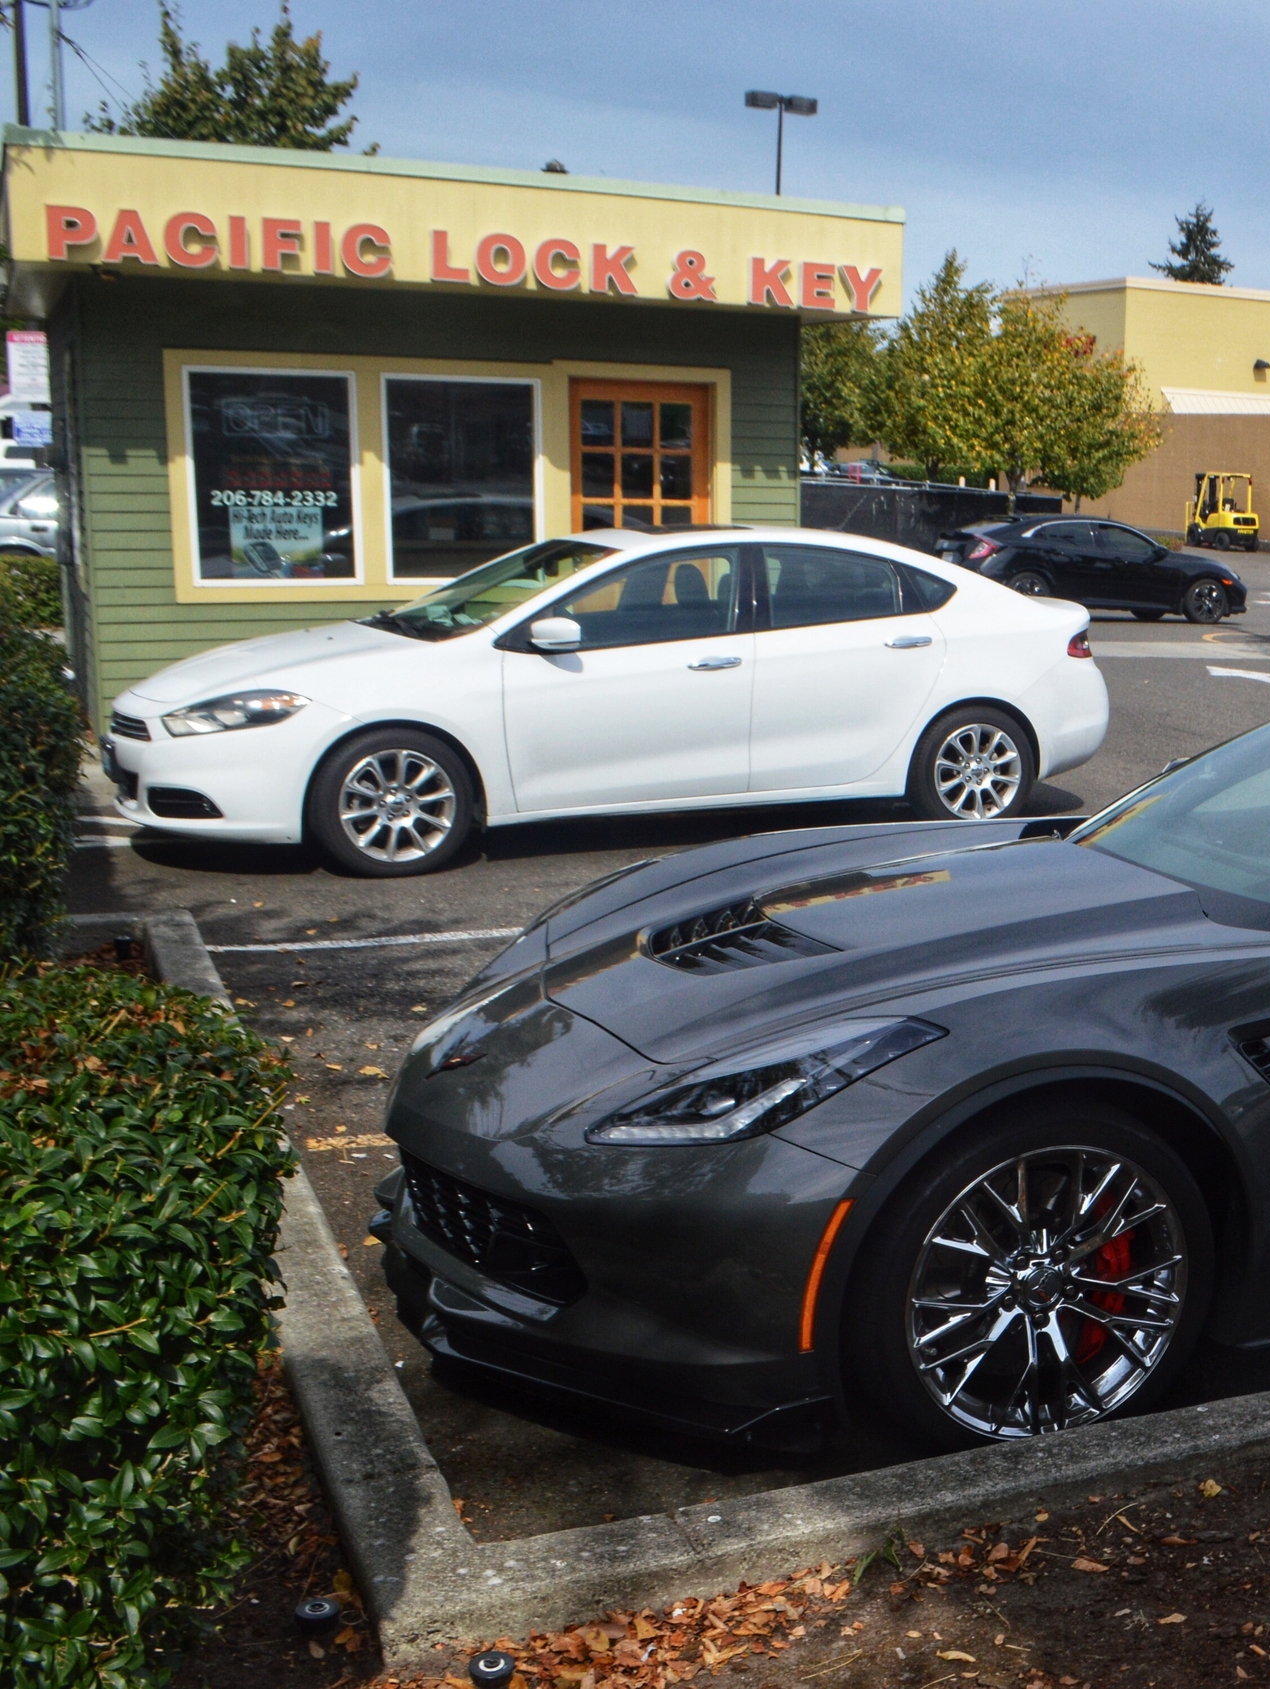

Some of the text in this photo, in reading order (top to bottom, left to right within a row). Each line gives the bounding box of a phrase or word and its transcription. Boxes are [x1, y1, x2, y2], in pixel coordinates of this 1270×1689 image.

[45, 204, 883, 313] PACIFIC LOCK & KEY
[210, 489, 338, 507] 206-784-2332
[270, 508, 294, 525] Auto
[296, 508, 320, 528] Keys
[244, 525, 273, 540] Made
